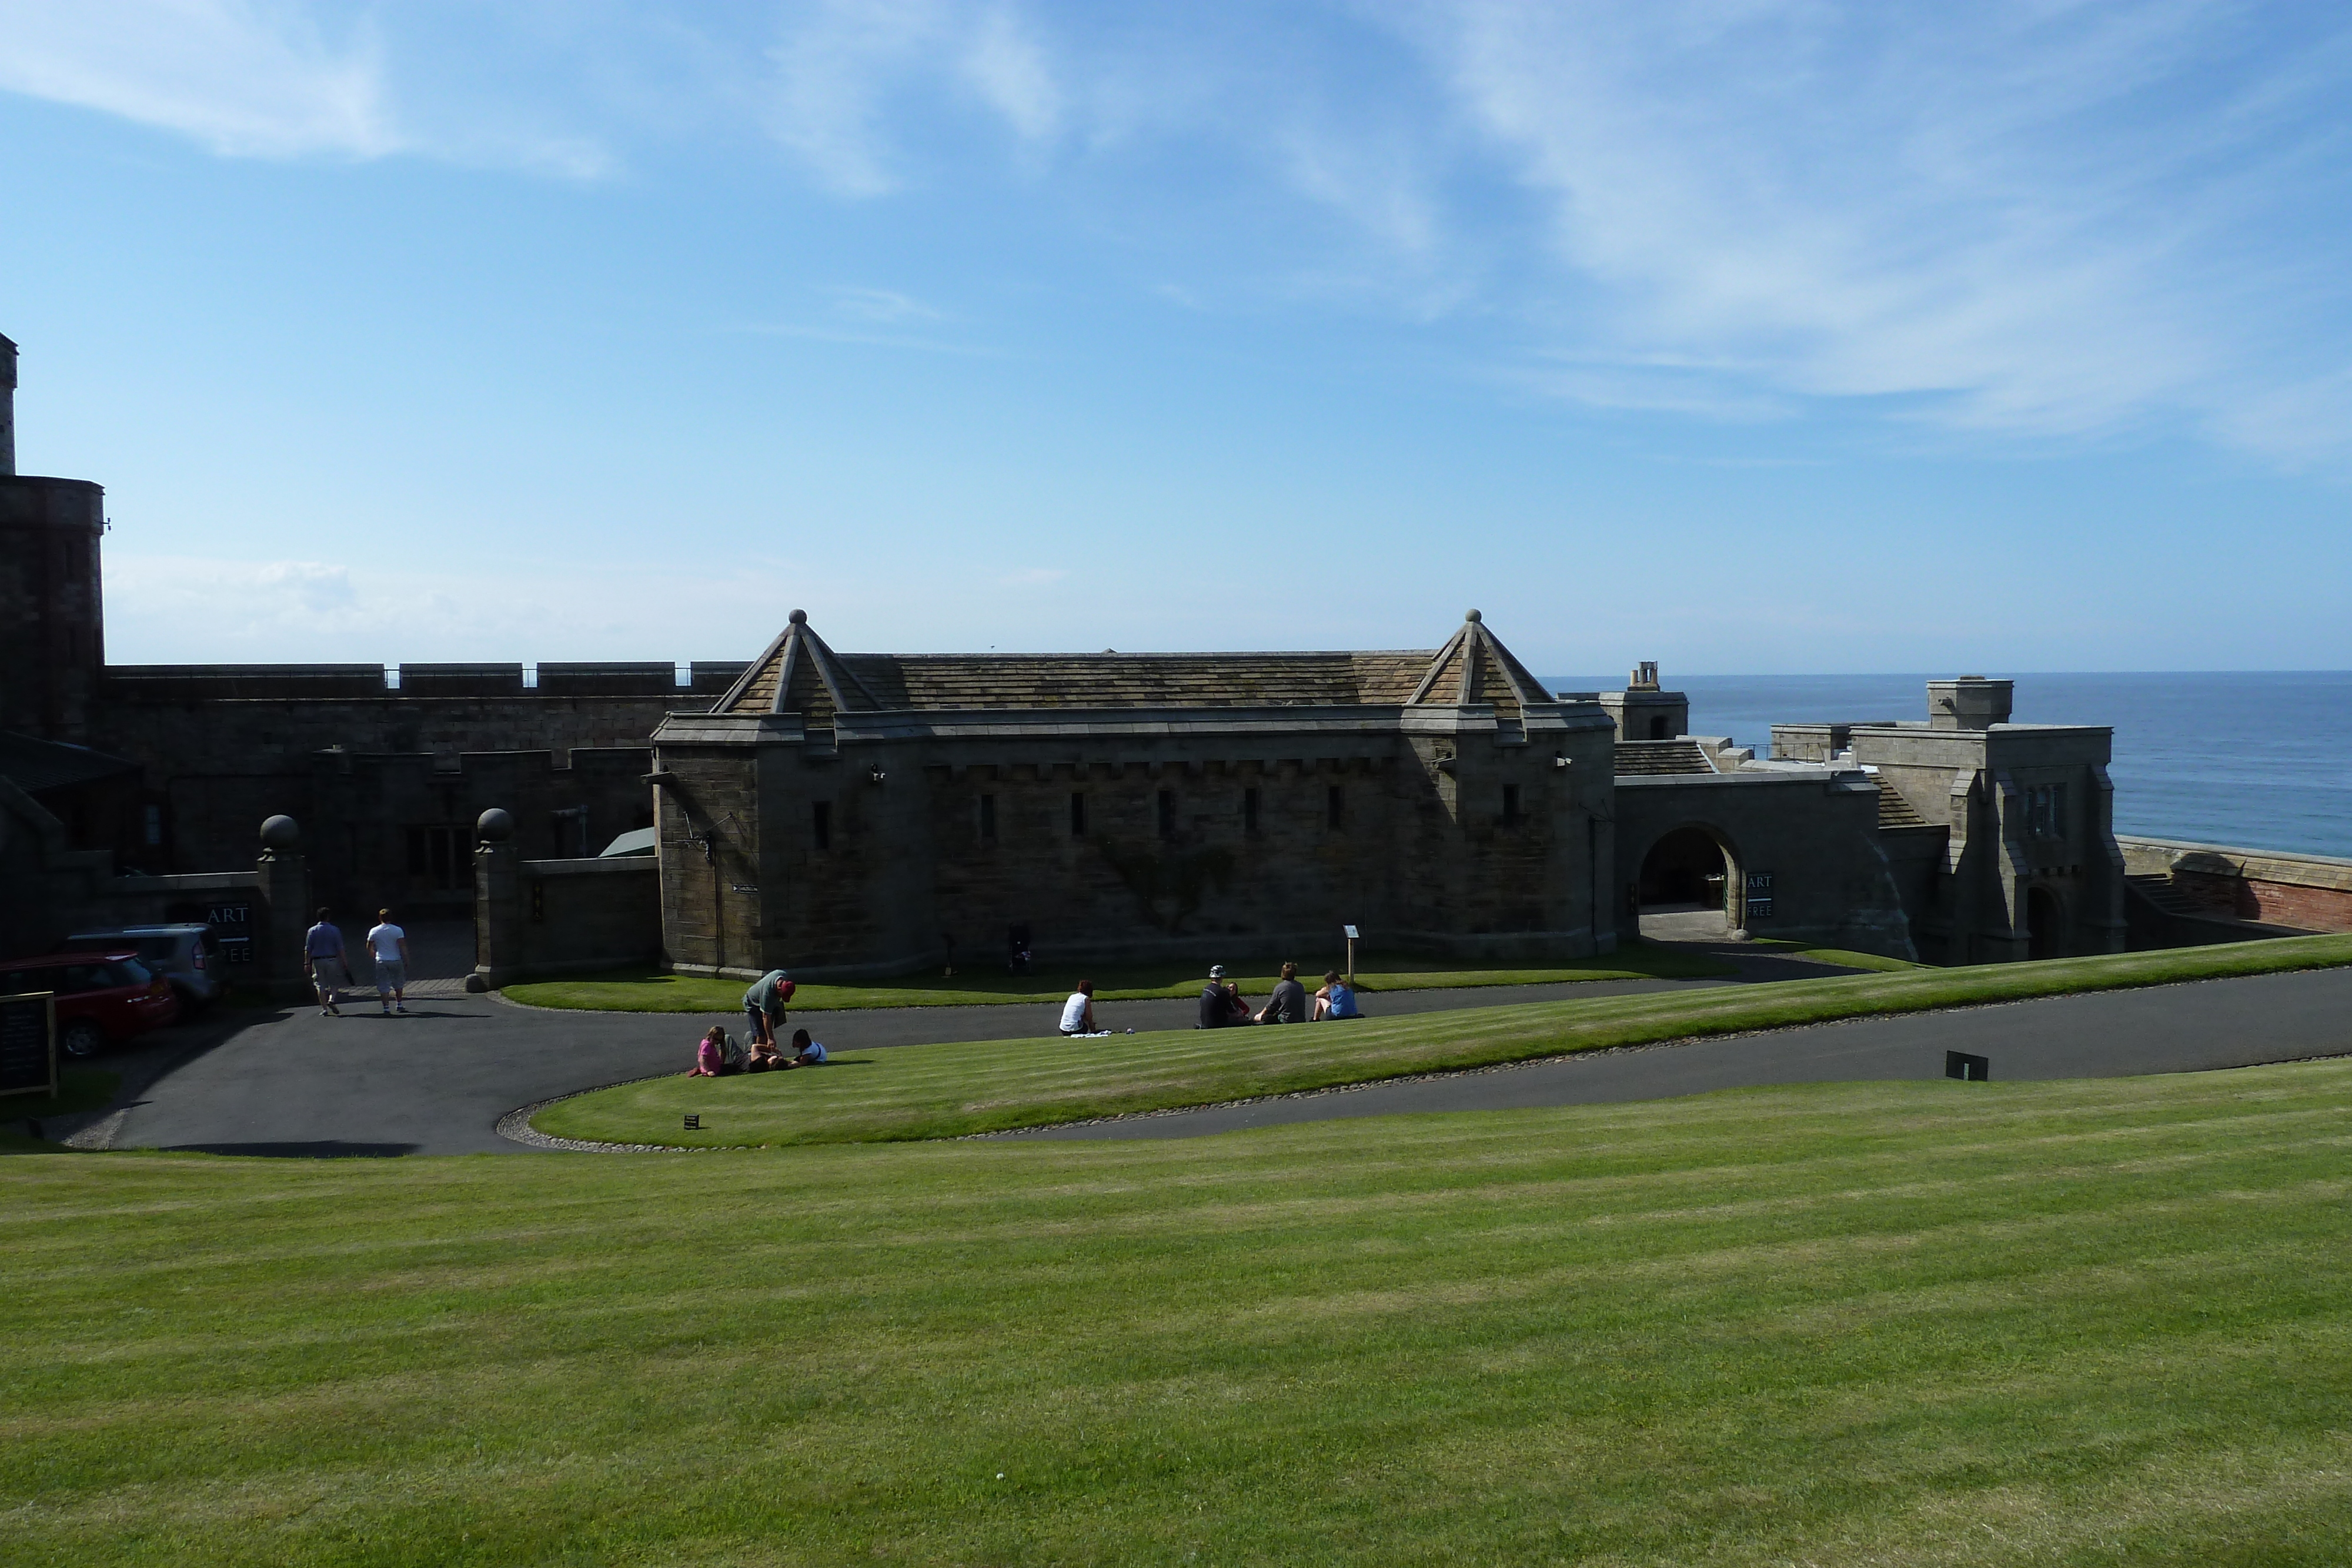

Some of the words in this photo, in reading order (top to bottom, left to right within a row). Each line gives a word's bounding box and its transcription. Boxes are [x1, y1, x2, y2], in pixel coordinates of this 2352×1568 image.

[1747, 876, 1772, 888] ART
[207, 907, 249, 923] ART
[1747, 905, 1772, 916] FREE
